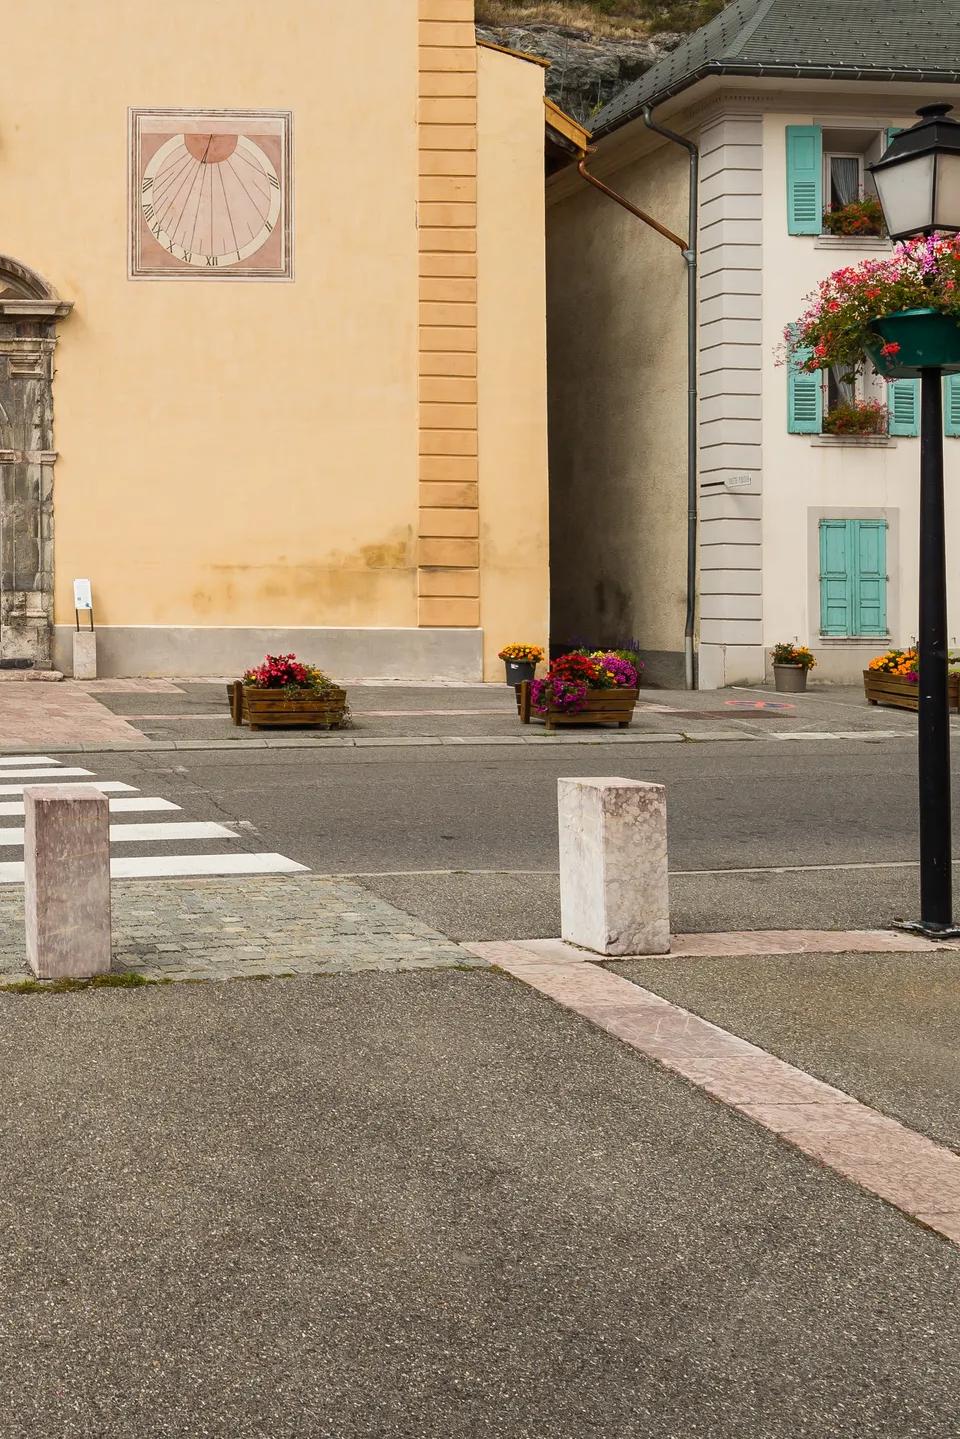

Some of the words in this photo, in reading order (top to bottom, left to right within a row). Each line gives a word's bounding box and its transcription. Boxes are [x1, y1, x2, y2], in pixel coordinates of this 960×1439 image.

[142, 177, 154, 193] VII
[142, 203, 155, 222] VIII
[151, 222, 163, 239] IX
[264, 220, 273, 233] II
[166, 240, 175, 253] X
[182, 249, 192, 263] XI
[206, 256, 218, 266] XII
